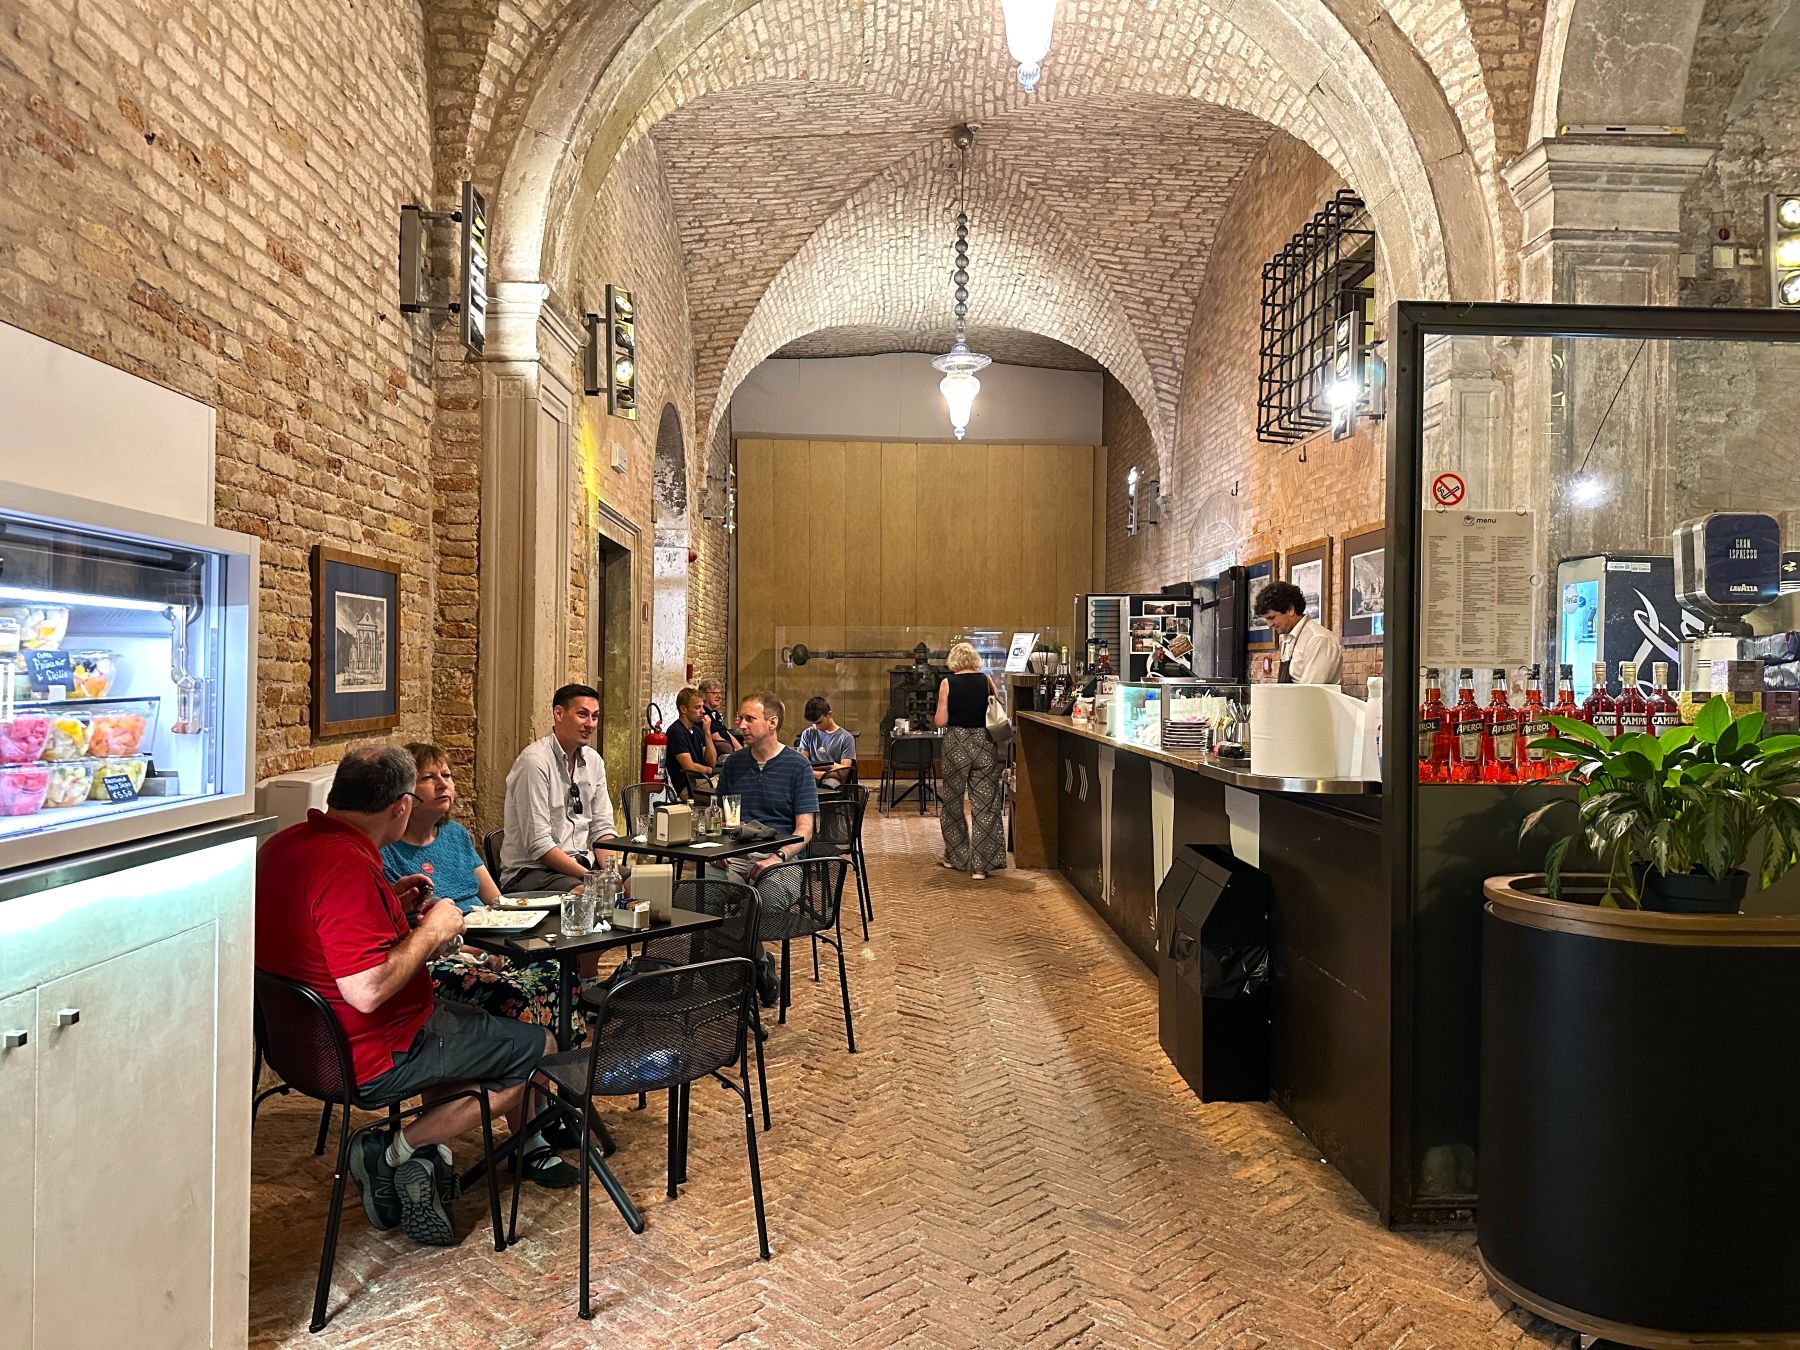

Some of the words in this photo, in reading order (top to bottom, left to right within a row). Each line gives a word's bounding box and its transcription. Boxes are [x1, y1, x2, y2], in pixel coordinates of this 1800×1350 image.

[1735, 538, 1751, 549] GRAN
[1729, 549, 1758, 559] ESPRESSO
[1729, 583, 1758, 592] LAVAZZA
[1456, 722, 1483, 735] APEROL
[1491, 723, 1517, 735] APEROL
[1522, 723, 1550, 735] APEROL
